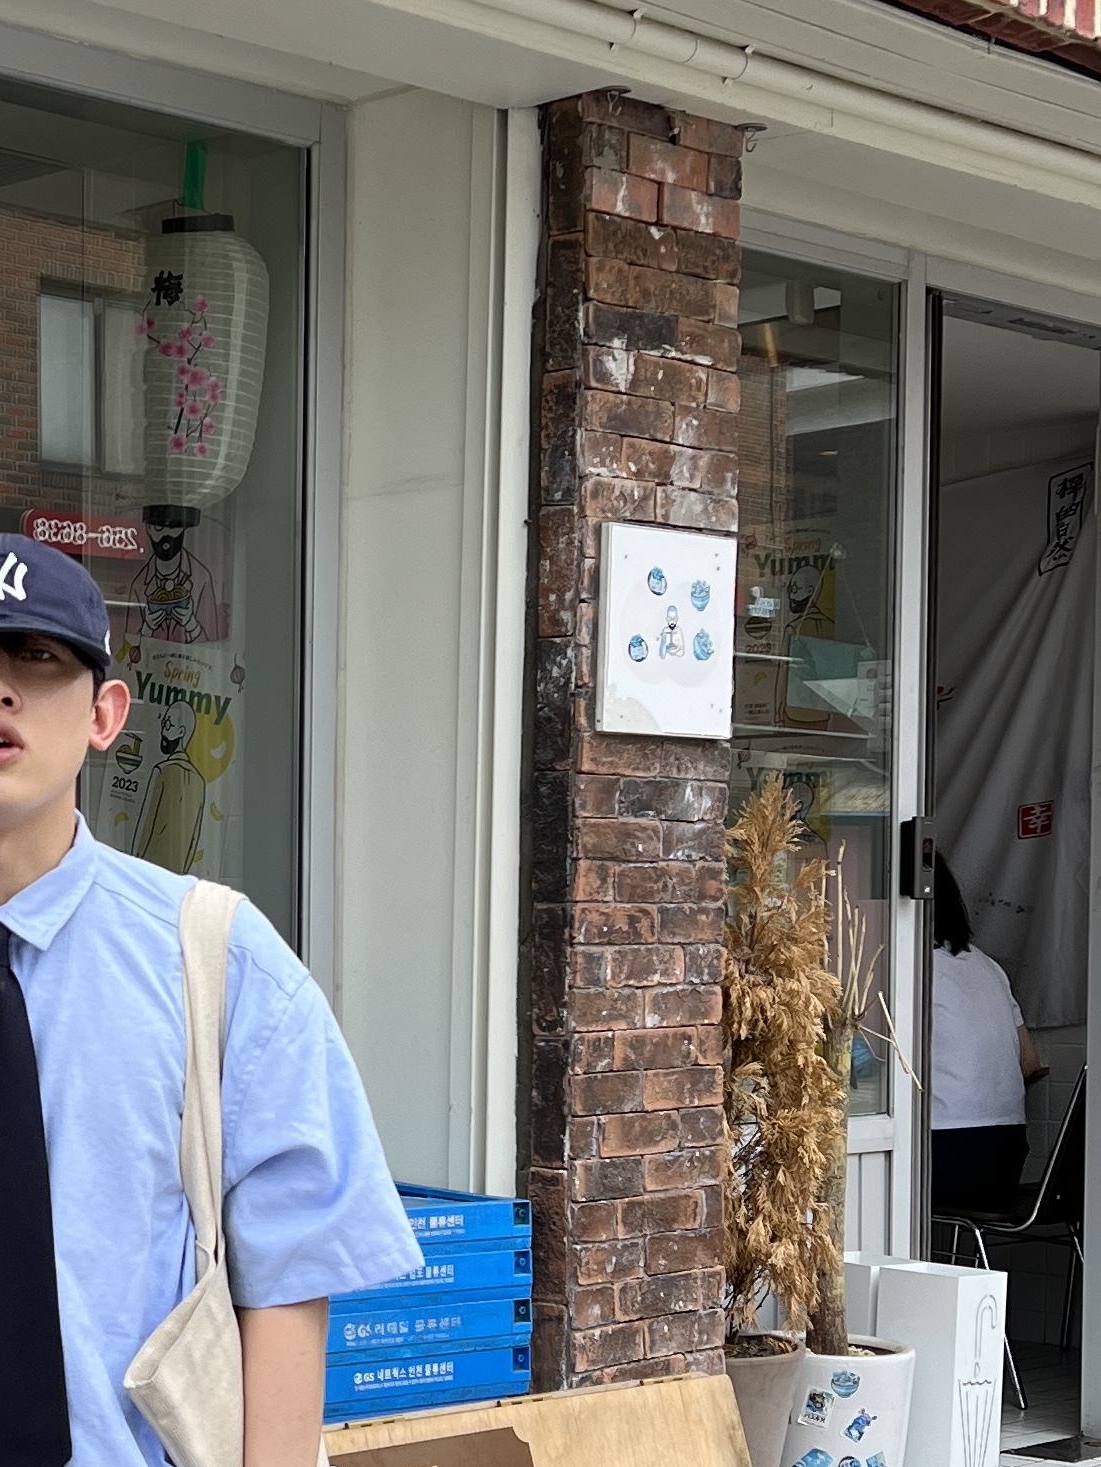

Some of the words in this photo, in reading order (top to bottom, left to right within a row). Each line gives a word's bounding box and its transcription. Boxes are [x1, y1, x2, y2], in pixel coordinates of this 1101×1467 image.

[151, 270, 184, 307] 梅
[164, 660, 202, 689] Spring
[135, 669, 233, 726] Yummy
[111, 776, 139, 793] 2023
[1022, 803, 1053, 834] 幸
